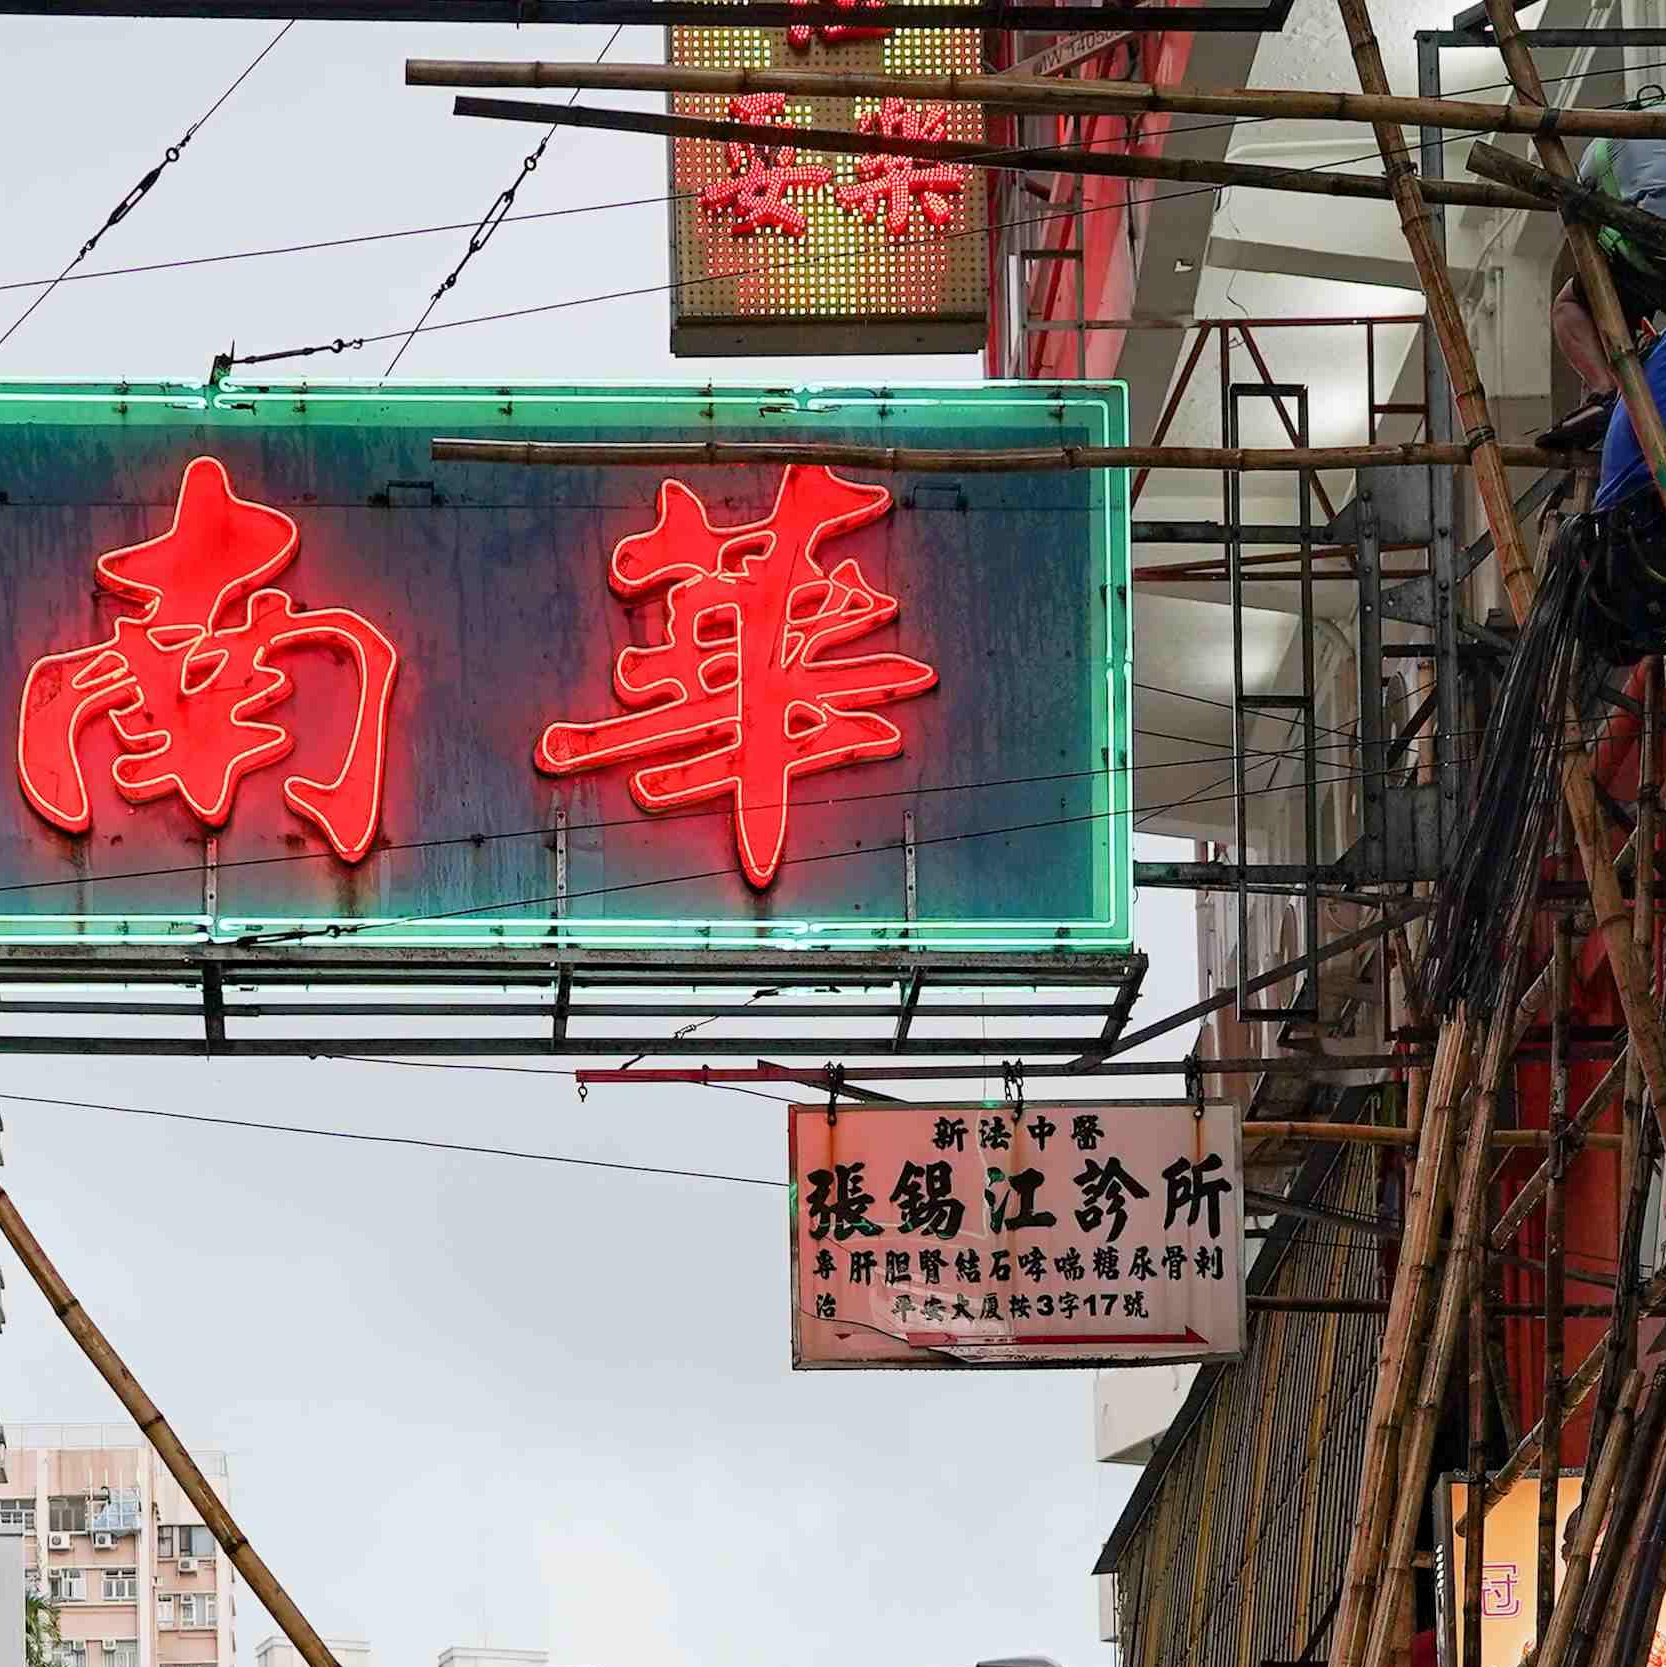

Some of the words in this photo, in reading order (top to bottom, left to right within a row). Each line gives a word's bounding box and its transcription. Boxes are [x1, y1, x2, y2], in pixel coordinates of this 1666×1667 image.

[932, 1115, 1105, 1152] 新法中醫
[806, 1153, 1233, 1242] 張錫江診所
